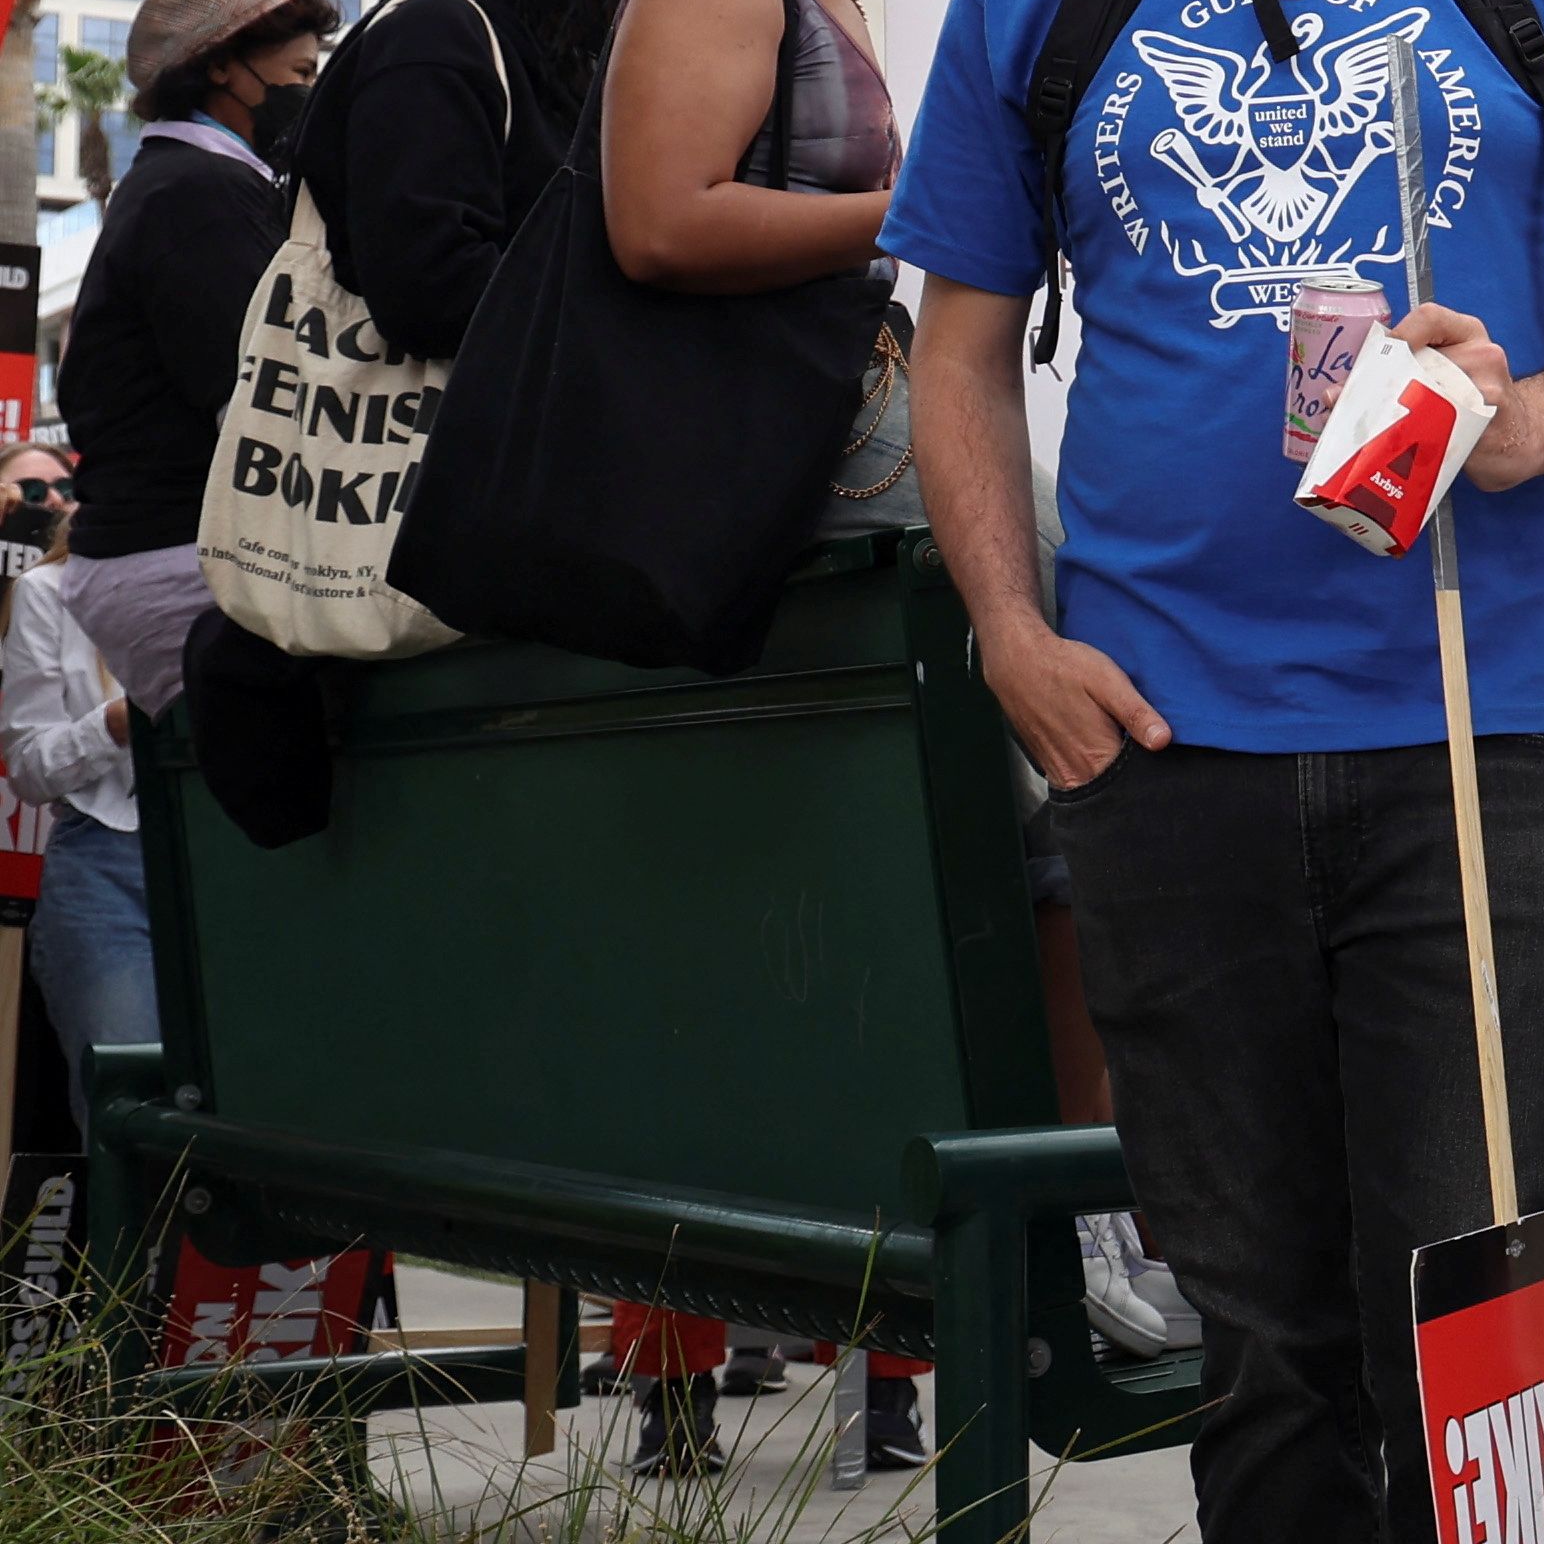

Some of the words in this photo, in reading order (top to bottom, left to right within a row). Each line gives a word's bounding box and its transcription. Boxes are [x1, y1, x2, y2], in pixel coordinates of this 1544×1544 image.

[1255, 105, 1308, 122] united
[1270, 121, 1293, 134] we
[1259, 132, 1305, 148] stand
[1417, 47, 1481, 229] AMERICA
[1095, 70, 1150, 256] WRITERS
[1247, 282, 1302, 304] WES
[1369, 471, 1405, 500] Arby's
[239, 537, 265, 555] Cafe
